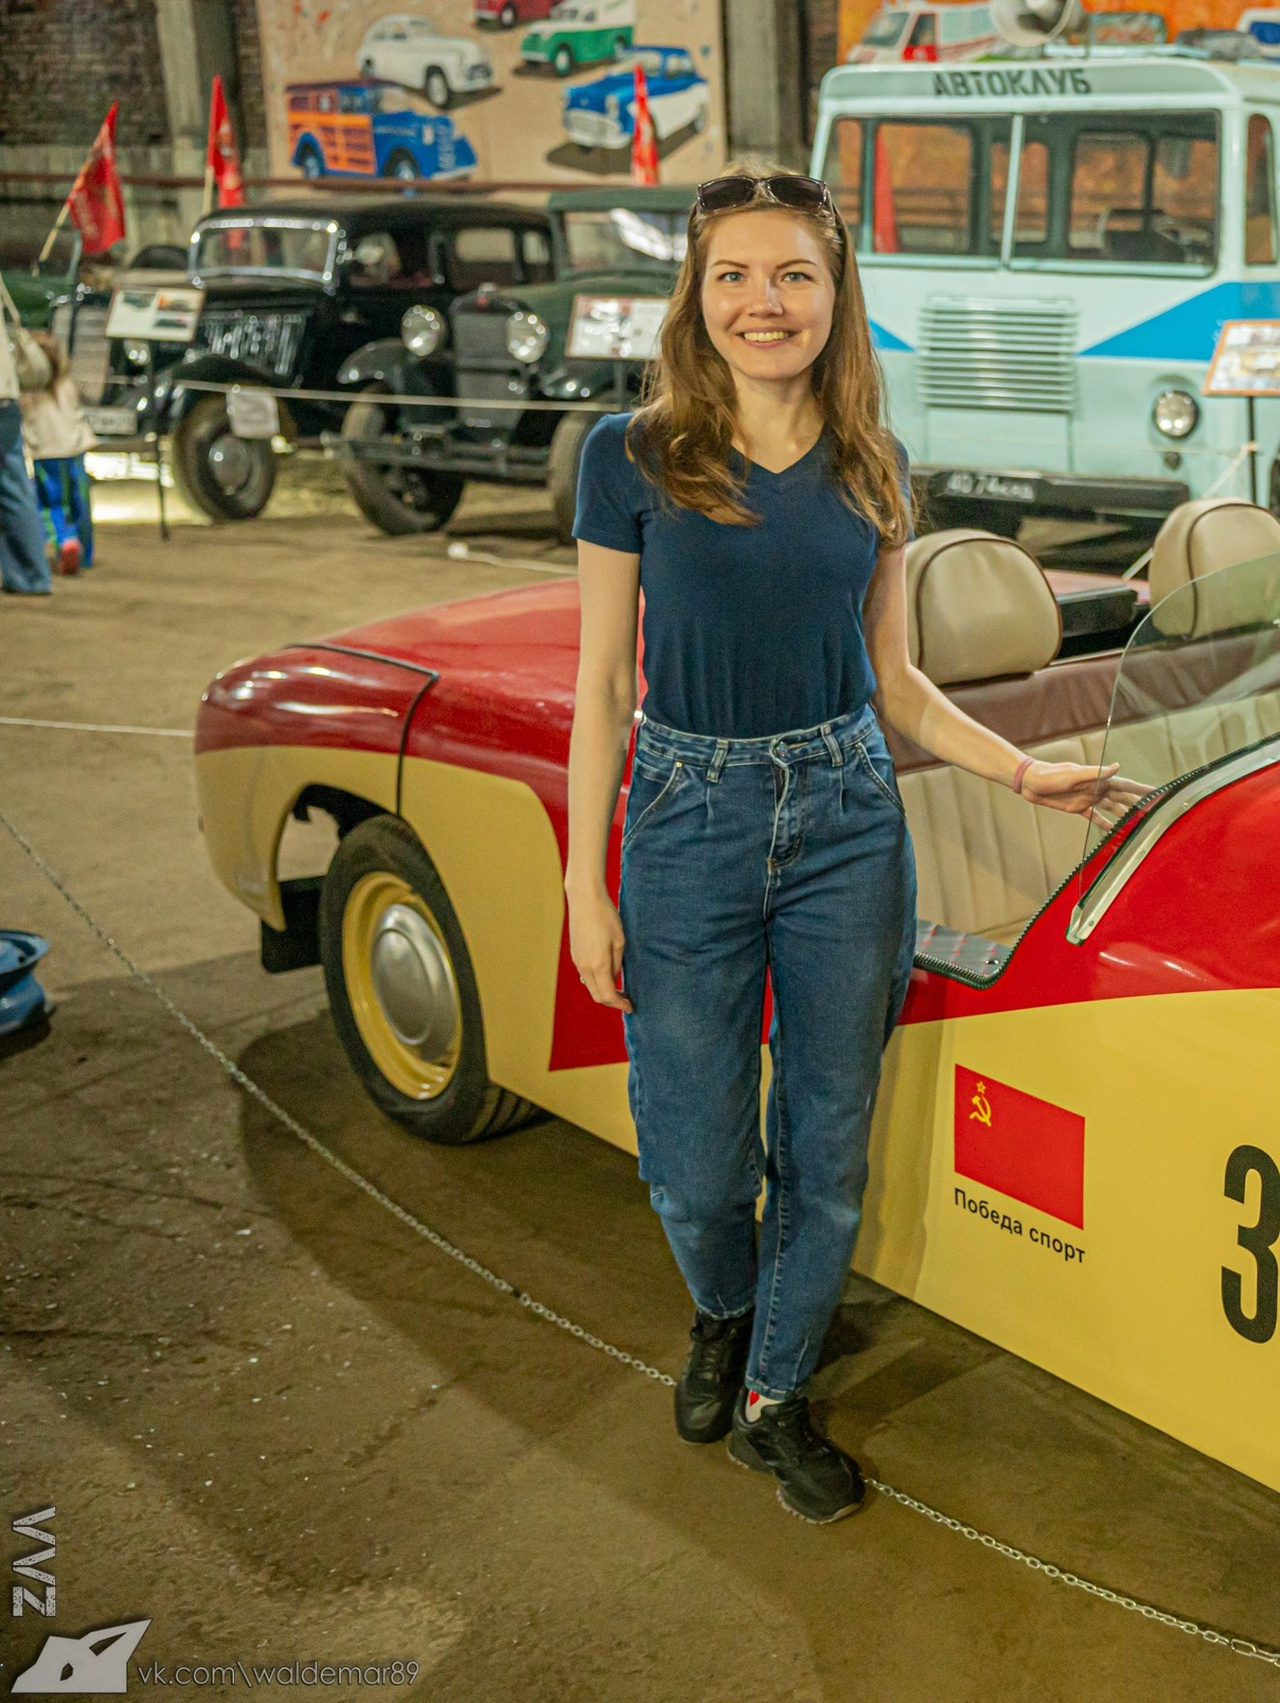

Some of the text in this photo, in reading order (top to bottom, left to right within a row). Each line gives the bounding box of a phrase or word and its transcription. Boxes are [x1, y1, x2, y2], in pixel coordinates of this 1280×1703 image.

[933, 68, 1091, 96] АВТОКЛУБ
[954, 1187, 1086, 1263] Победа спорт
